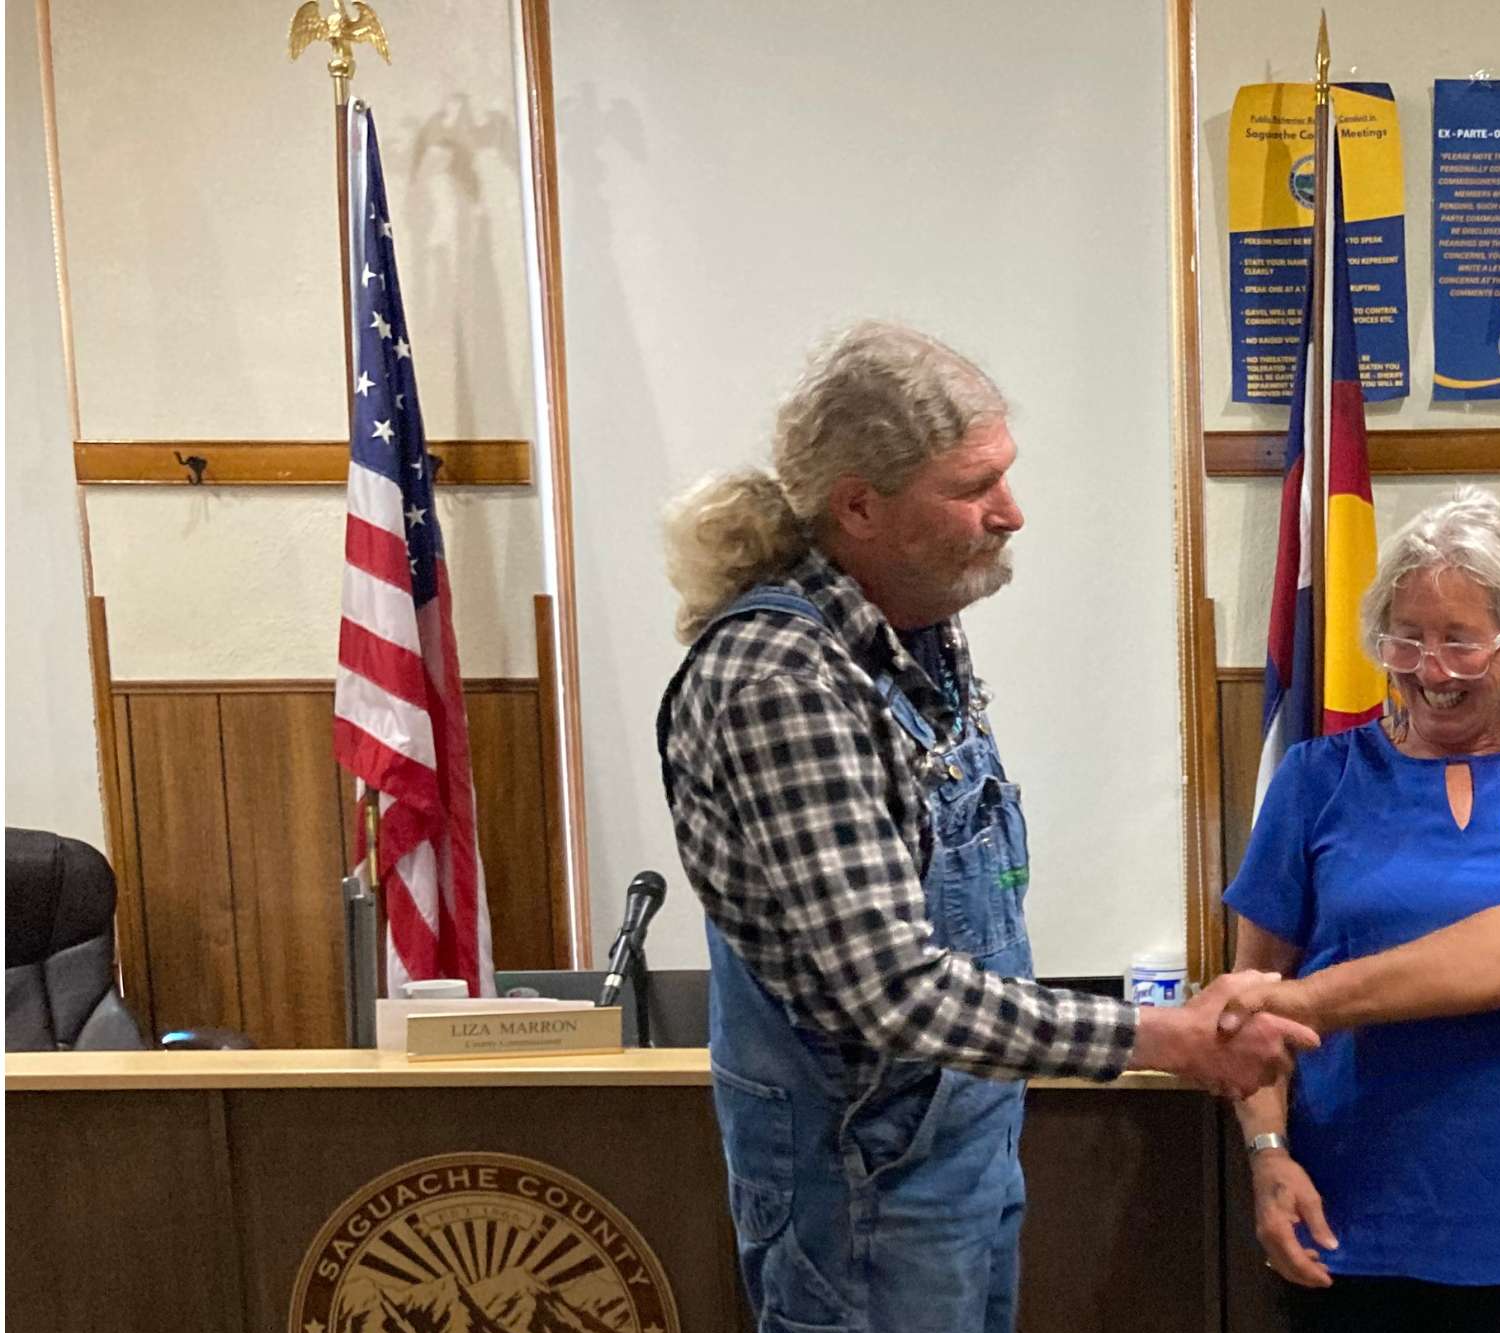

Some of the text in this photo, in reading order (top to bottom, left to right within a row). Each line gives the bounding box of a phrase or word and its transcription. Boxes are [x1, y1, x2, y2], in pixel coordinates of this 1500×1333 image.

[1245, 128, 1387, 140] Saguache Meetings
[1438, 129, 1450, 138] EX
[1457, 129, 1488, 138] PARTE
[451, 1020, 578, 1038] LIZA MARRON
[318, 1167, 651, 1288] SAGUACHE COUNTY
